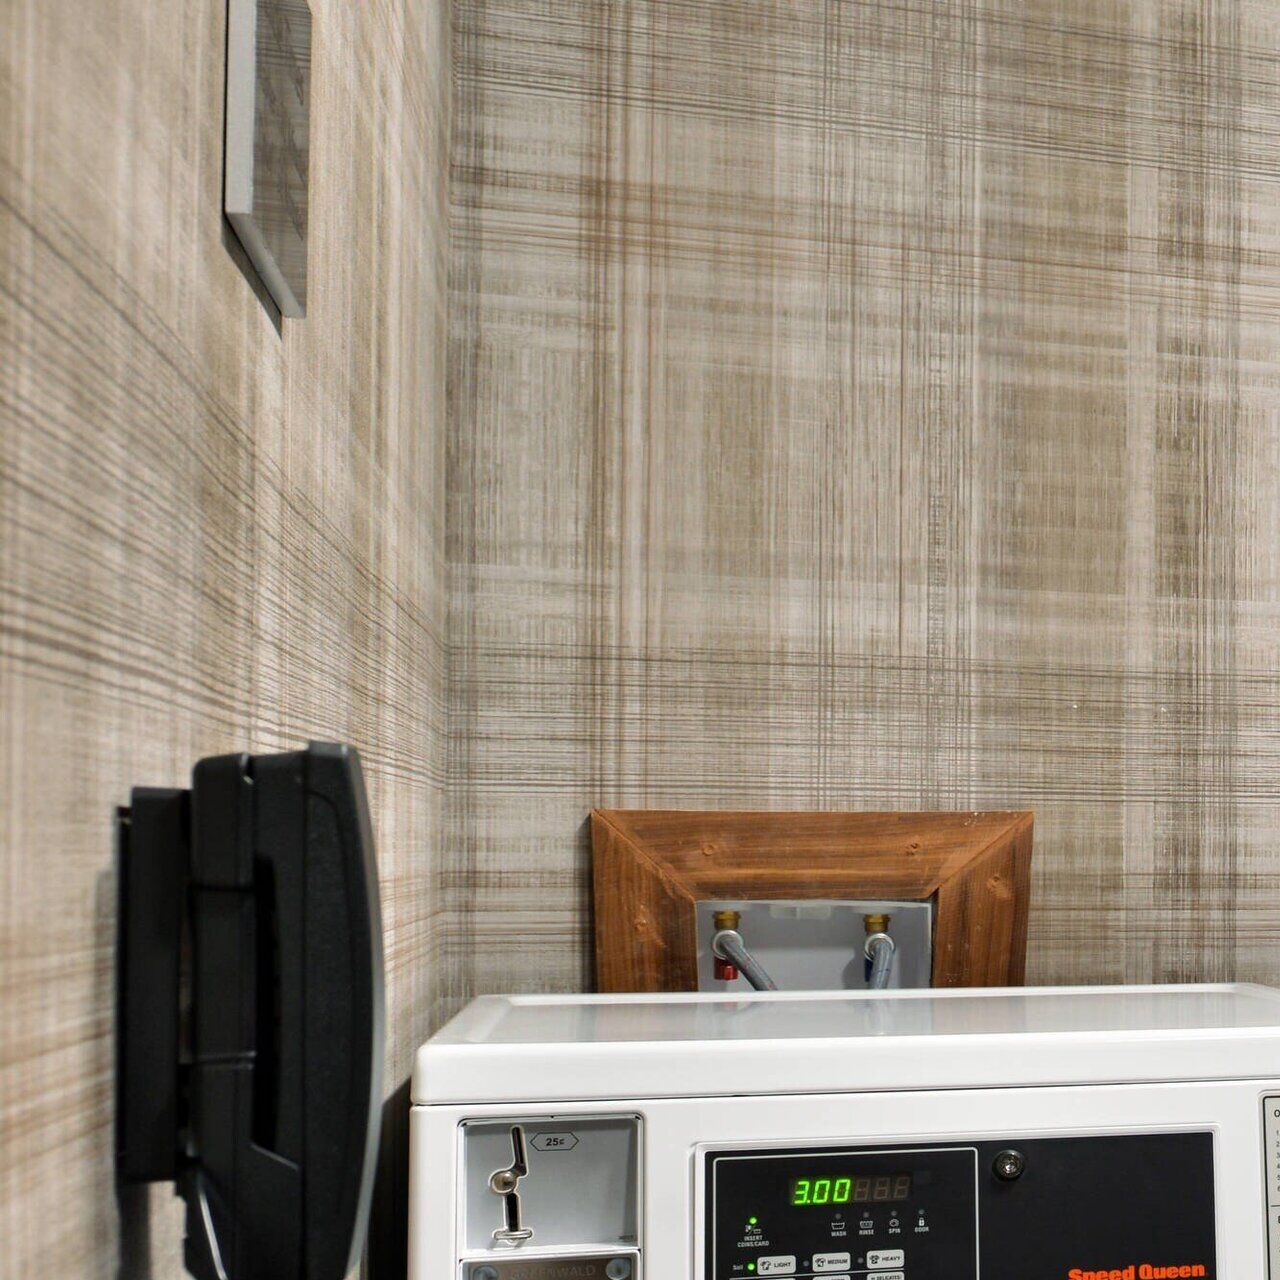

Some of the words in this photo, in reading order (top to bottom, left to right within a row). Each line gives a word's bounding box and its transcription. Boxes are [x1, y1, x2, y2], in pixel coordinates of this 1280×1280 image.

[794, 1179, 851, 1205] 3.00
[738, 1240, 770, 1248] COINS/CARD
[1139, 1264, 1205, 1280] Queen
